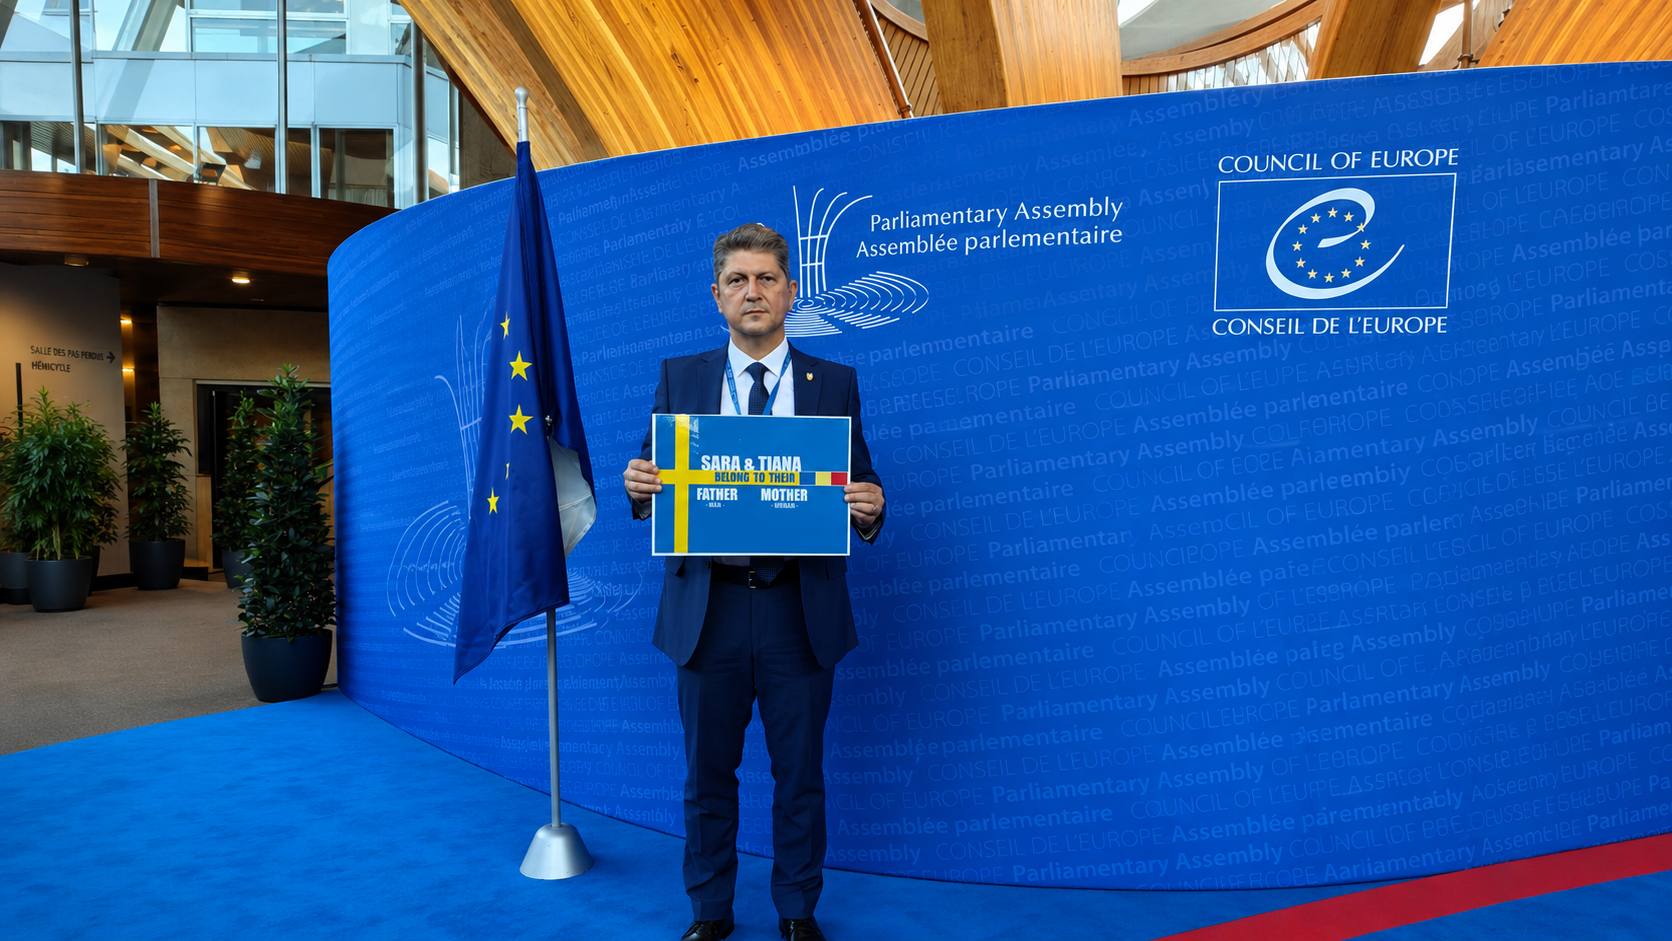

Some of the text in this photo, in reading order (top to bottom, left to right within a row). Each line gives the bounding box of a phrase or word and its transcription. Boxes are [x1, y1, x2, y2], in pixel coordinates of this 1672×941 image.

[1218, 153, 1322, 173] COUNCIL
[1330, 151, 1362, 169] OF
[1371, 148, 1459, 168] EUROPE
[870, 196, 1123, 232] Parliamentary Assembly
[856, 225, 1123, 258] Assemblée parlementaire
[1550, 280, 1672, 312] Parliamenta
[1212, 316, 1448, 336] CONSEIL DE L'EUROPE
[30, 345, 52, 356] SALLE
[53, 348, 66, 357] DES
[67, 349, 80, 359] PAS
[701, 455, 802, 472] SARA & TIANA
[714, 472, 749, 483] BELONG
[753, 472, 765, 483] TO
[696, 487, 738, 501] FATHER
[760, 488, 808, 502] MOTHER
